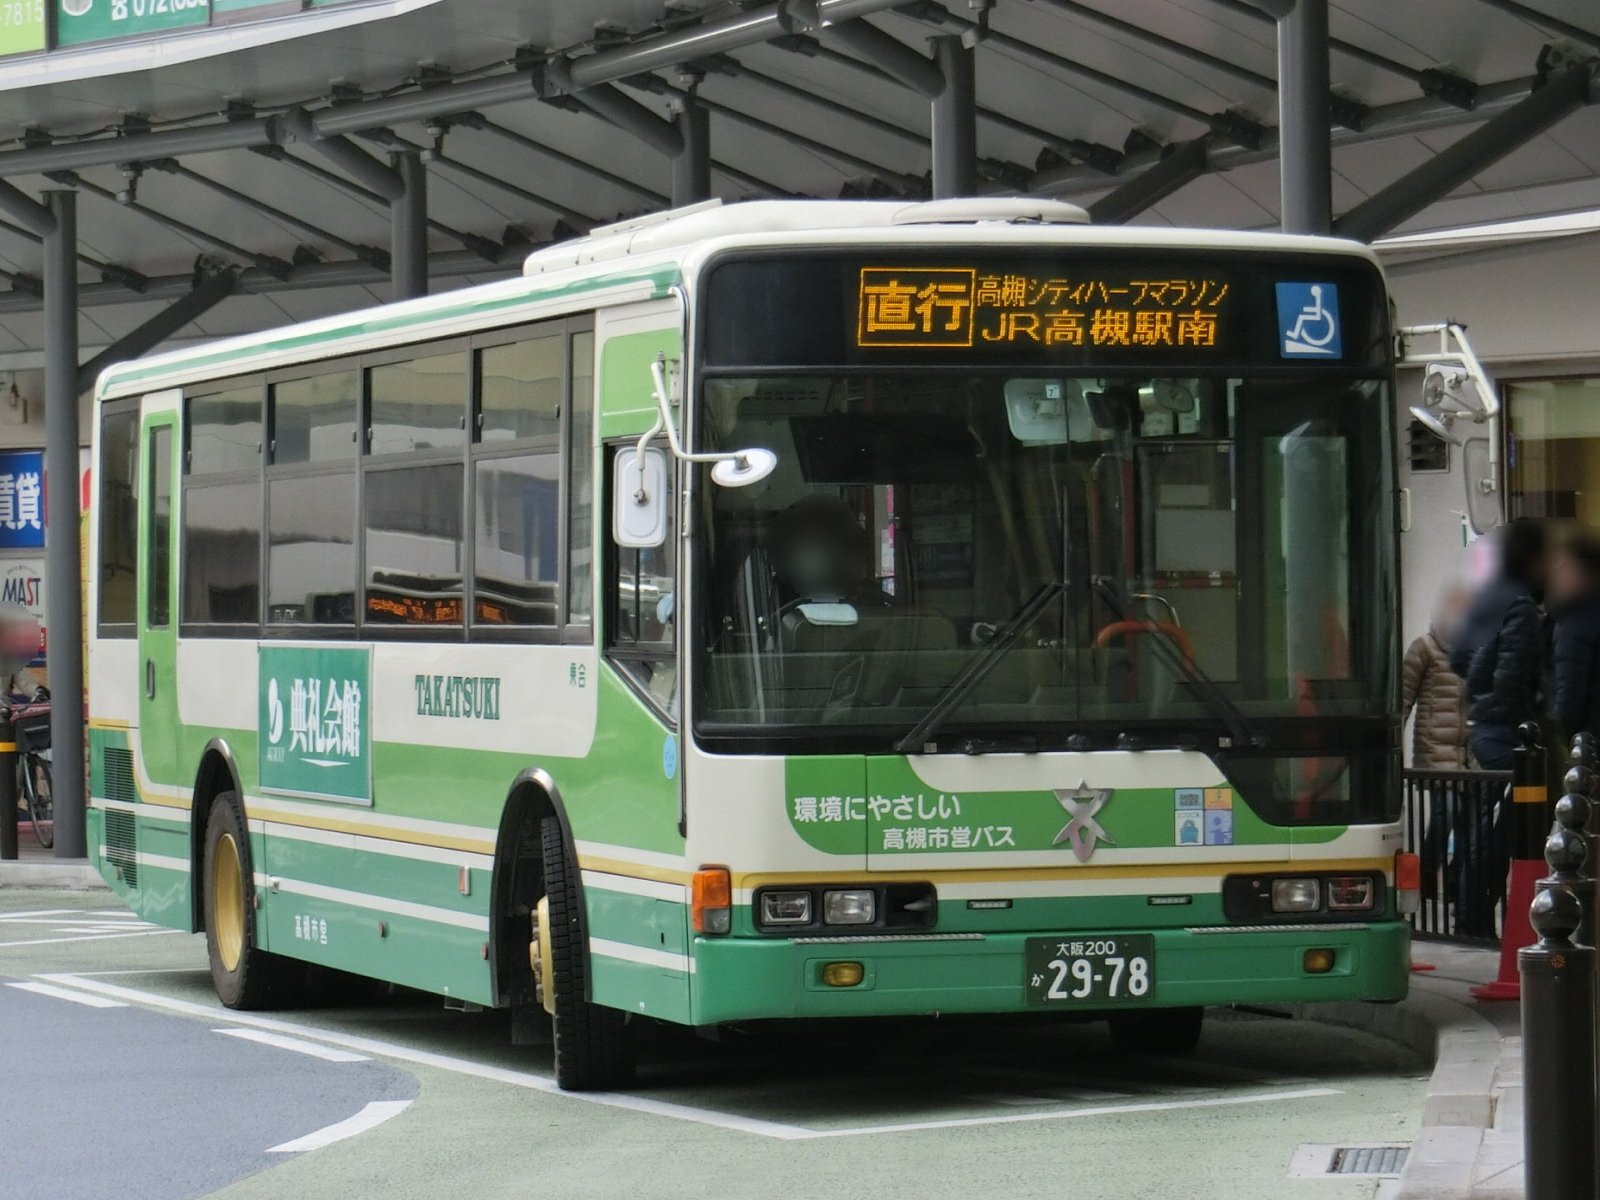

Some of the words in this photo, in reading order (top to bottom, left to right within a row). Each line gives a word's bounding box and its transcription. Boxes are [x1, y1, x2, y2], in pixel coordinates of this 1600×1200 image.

[864, 280, 970, 332] 直行
[977, 275, 1229, 307] 高槻シティハーフマラソン
[981, 309, 1218, 346] JR高槻駅南
[3, 577, 41, 606] MAST
[415, 675, 500, 720] TAKATSUKI
[289, 677, 361, 757] 典礼会館
[794, 794, 961, 822] 環境にやさしい
[883, 826, 1015, 850] 高槻市営バス
[1047, 957, 1148, 999] 29-78
